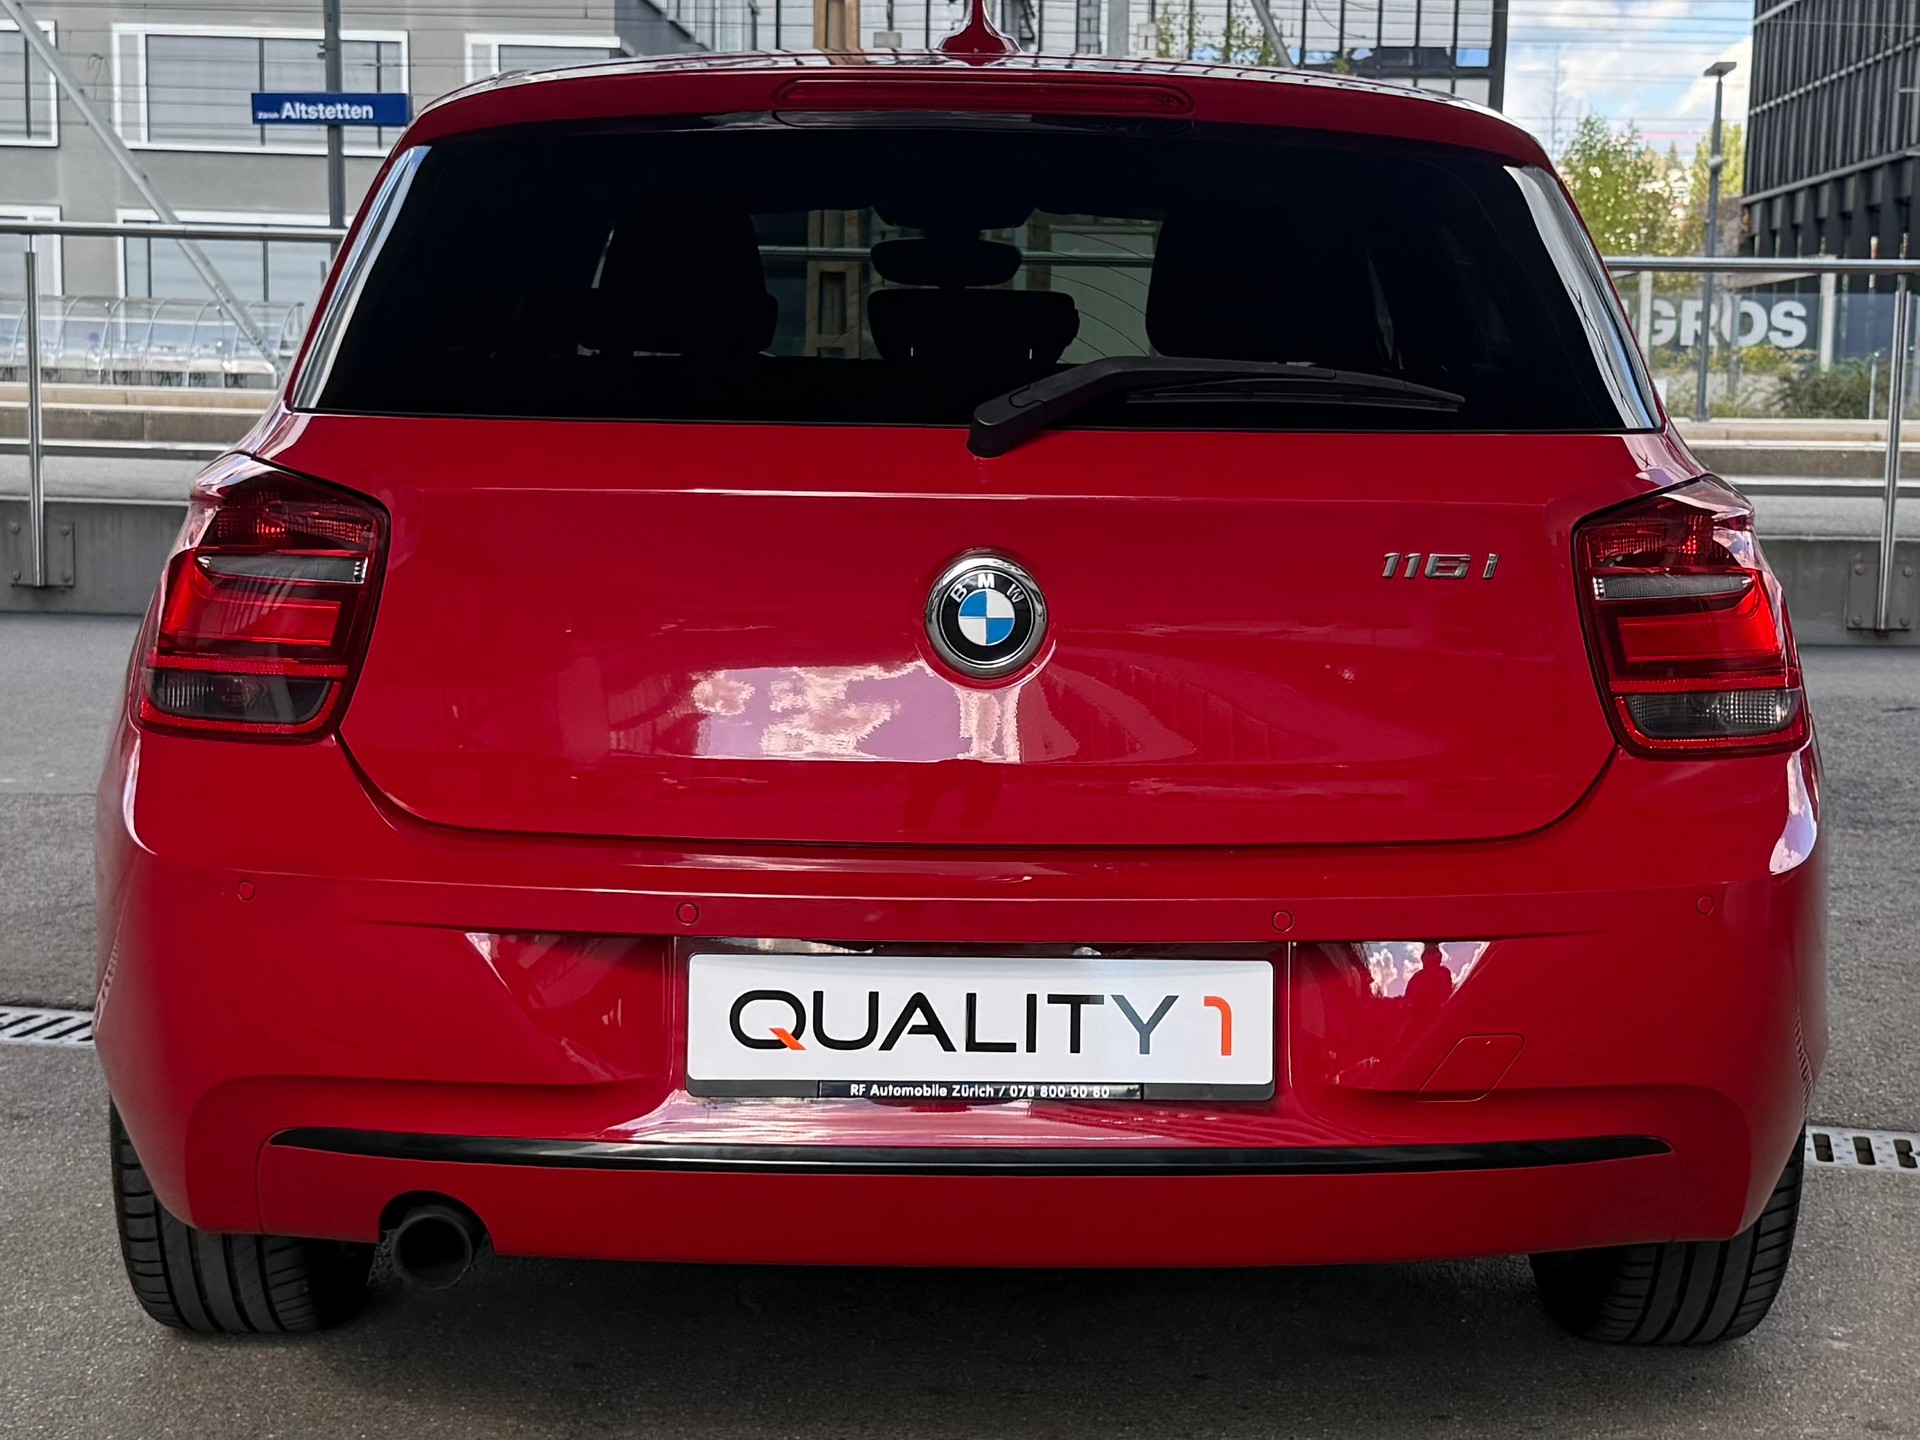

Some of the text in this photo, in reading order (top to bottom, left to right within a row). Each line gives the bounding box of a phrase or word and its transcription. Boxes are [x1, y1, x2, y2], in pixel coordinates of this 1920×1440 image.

[281, 101, 374, 120] Altstetten
[1621, 298, 1807, 349] GROS
[950, 573, 1025, 604] BMW
[729, 989, 1232, 1056] QUALITY 1
[850, 1083, 866, 1096] RF
[869, 1083, 948, 1097] Automobile
[951, 1084, 995, 1097] Zürich
